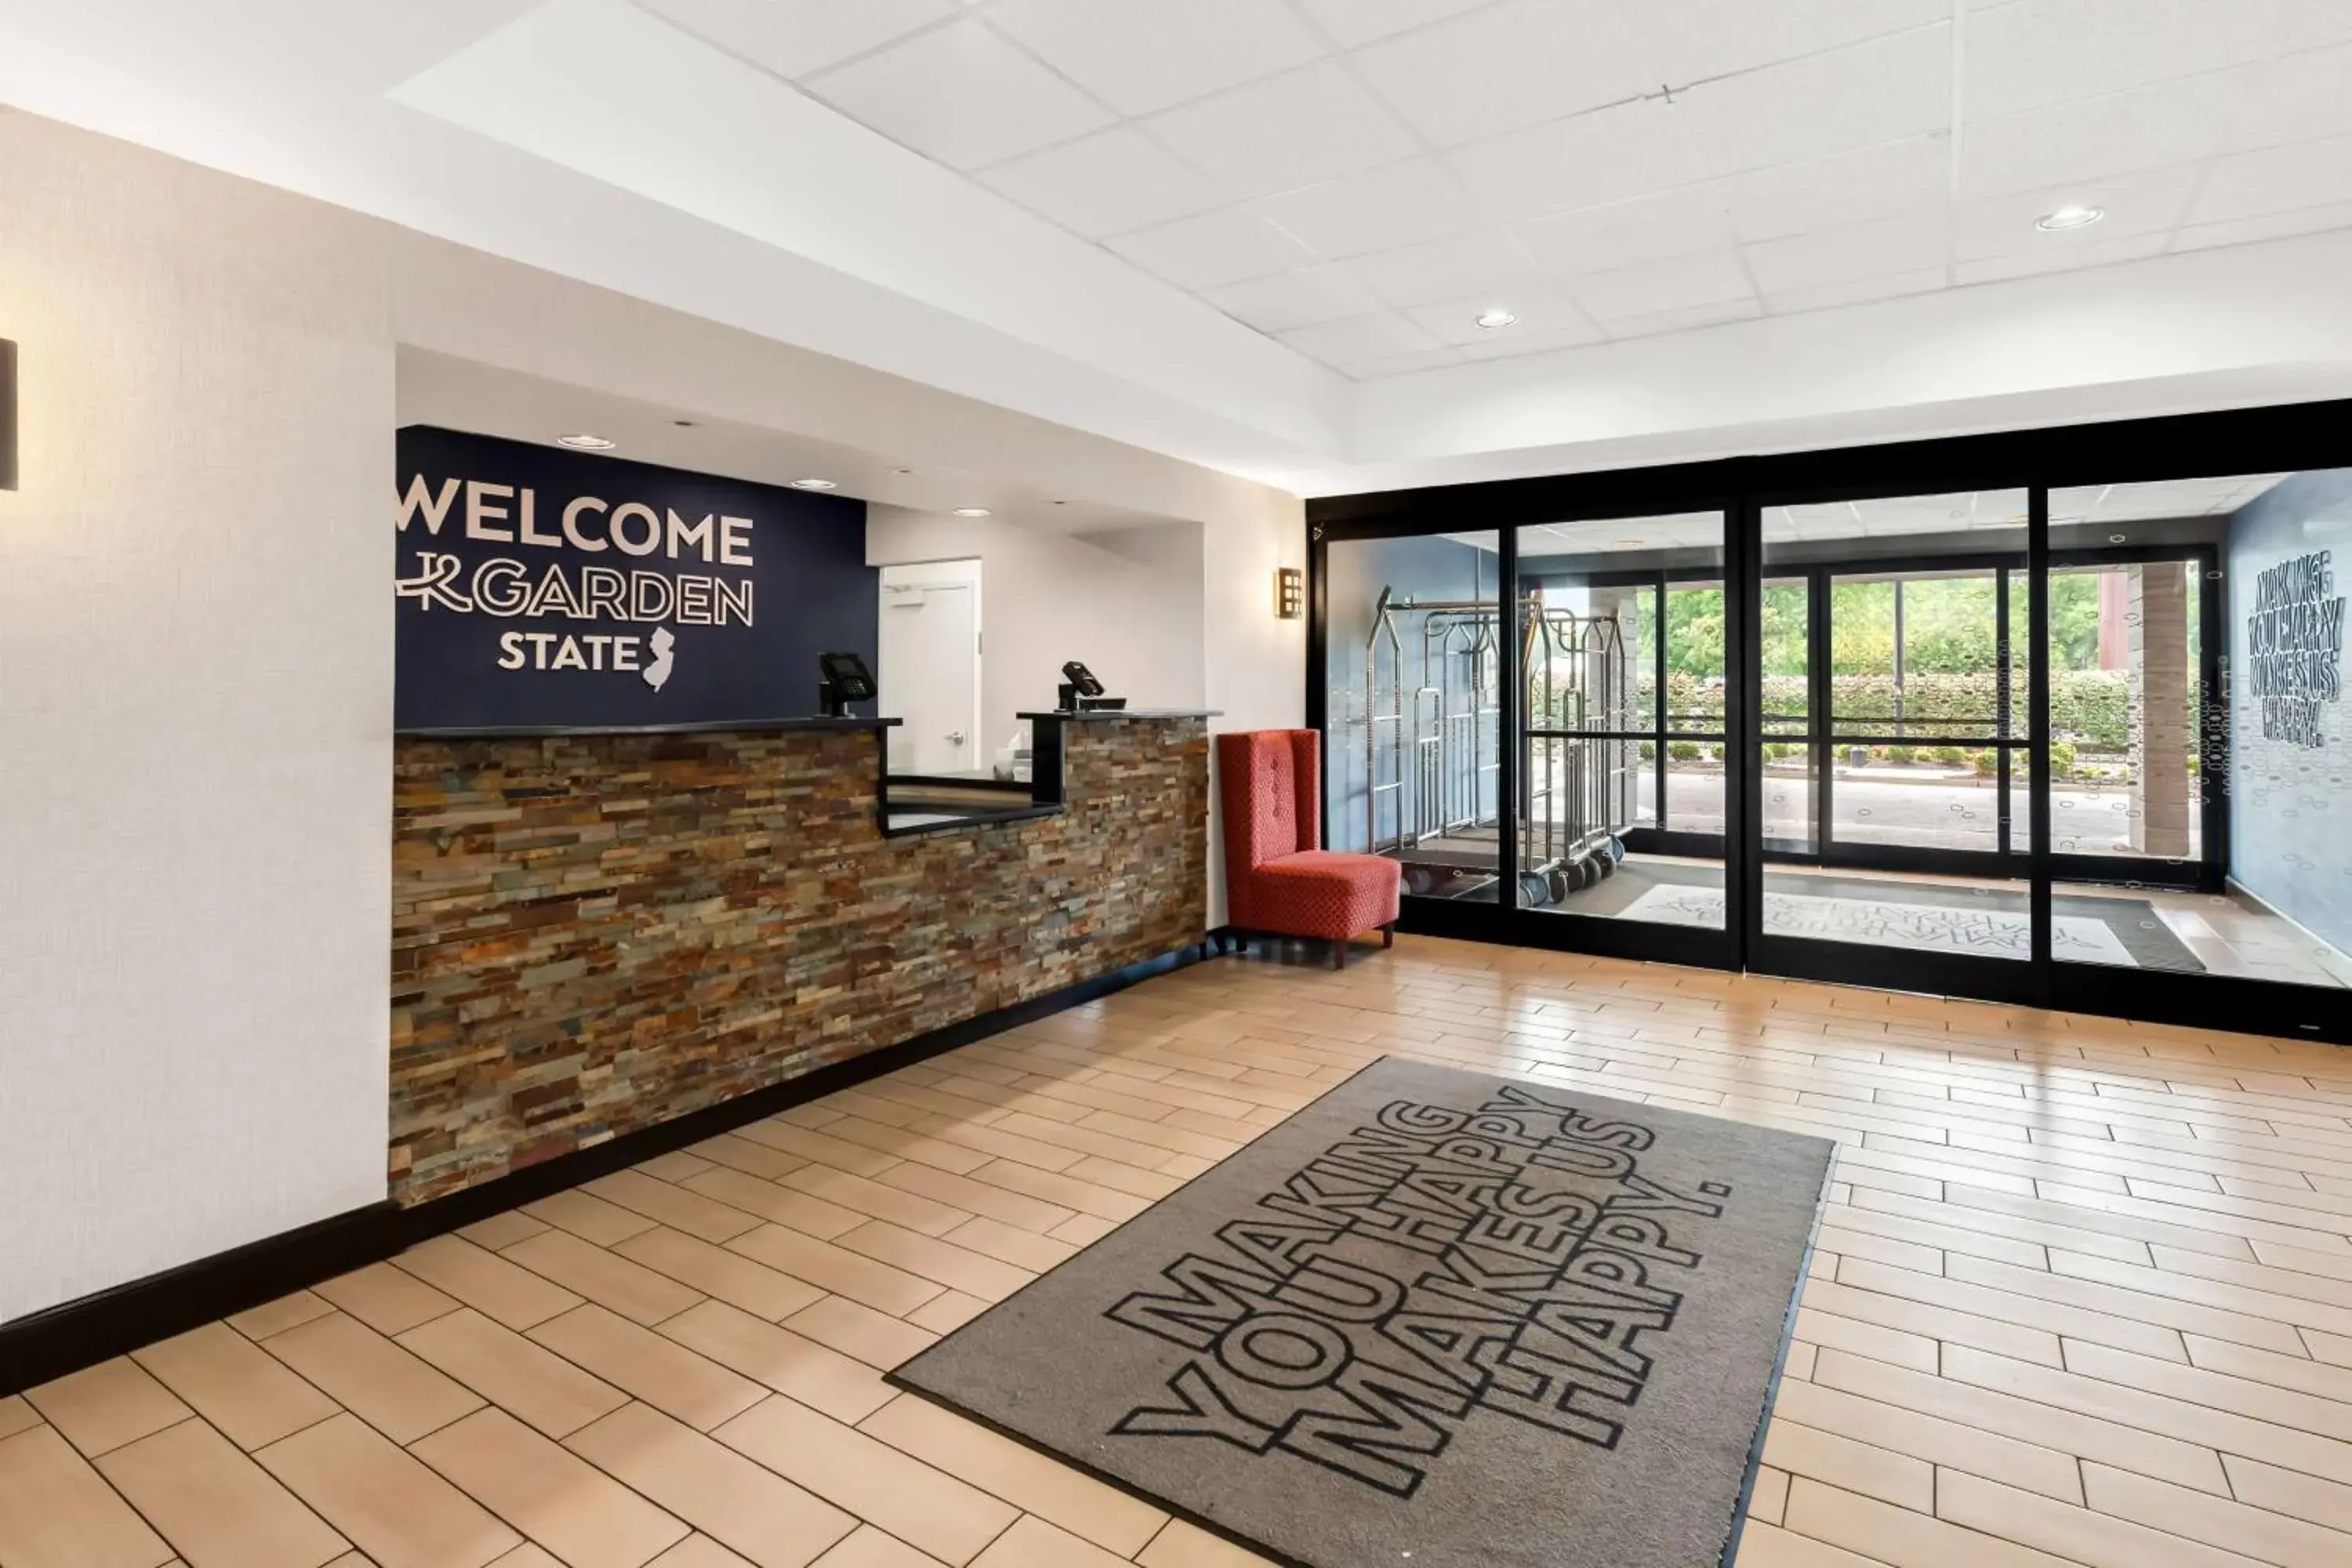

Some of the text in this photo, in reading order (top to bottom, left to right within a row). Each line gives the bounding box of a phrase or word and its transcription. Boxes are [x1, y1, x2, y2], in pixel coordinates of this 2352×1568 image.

[394, 473, 753, 566] WELCOME
[472, 557, 753, 626] GARDEN
[497, 631, 641, 671] STATE
[1102, 1099, 1473, 1354] MAKING
[1105, 1085, 1579, 1456] YOU HAPPY
[1273, 1107, 1657, 1500] MAKES US
[1474, 1171, 1732, 1451] HAPPY.
